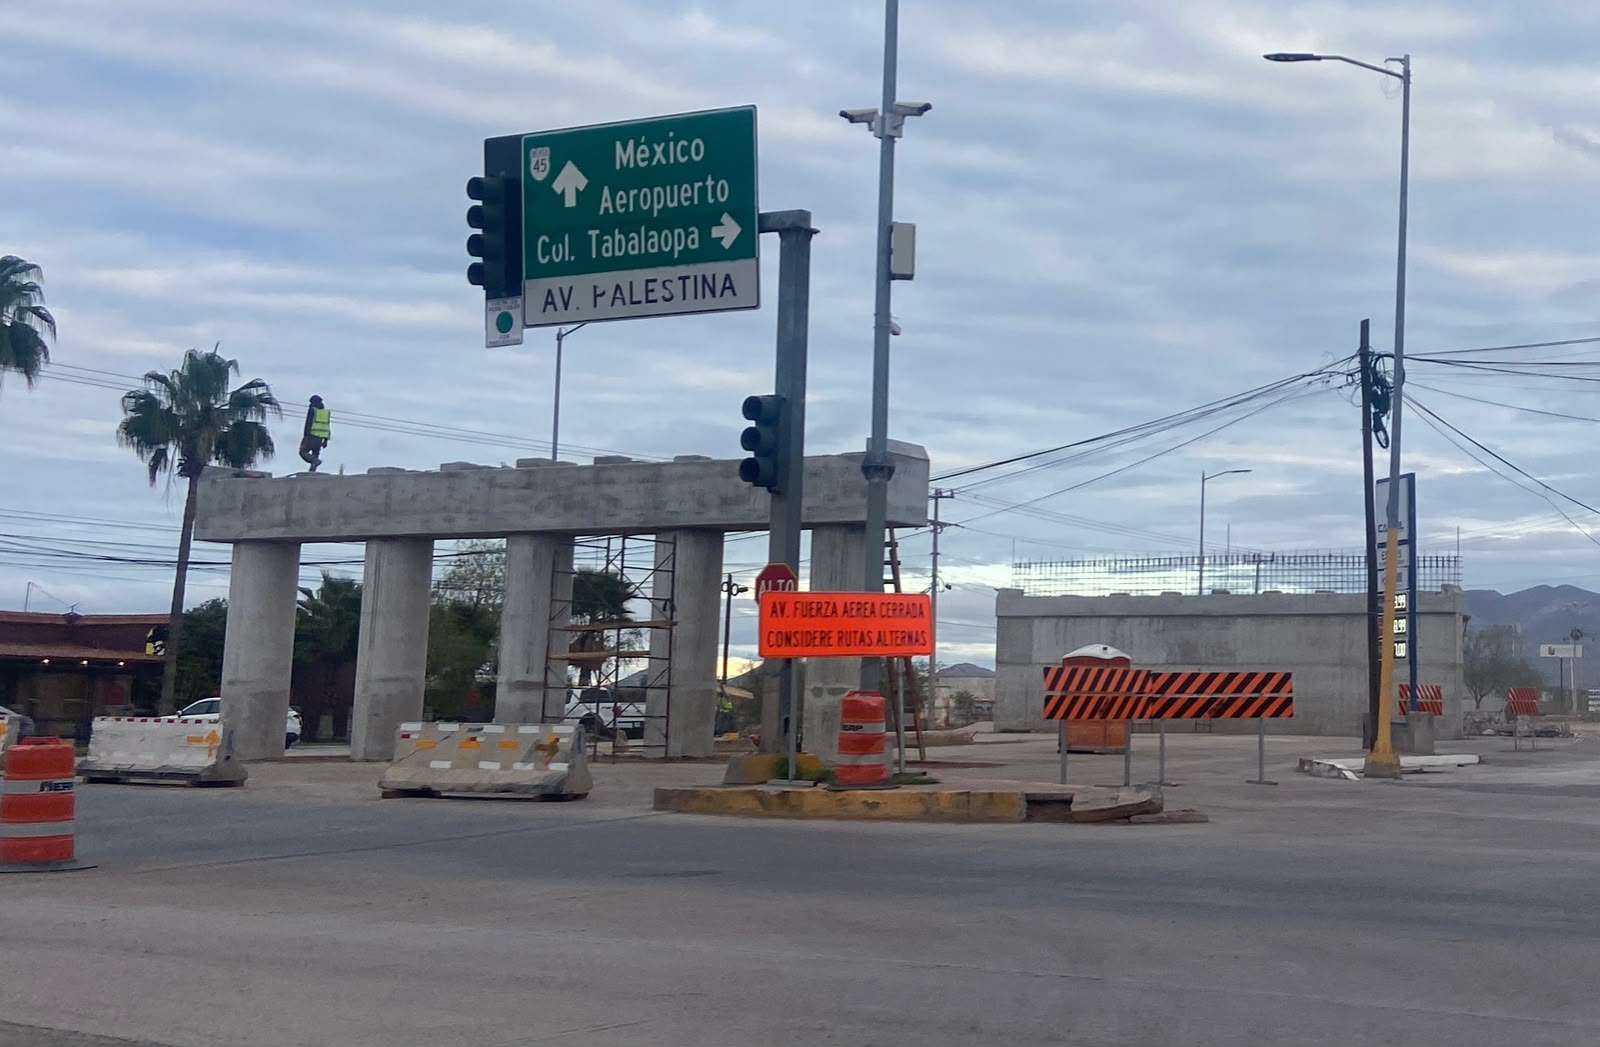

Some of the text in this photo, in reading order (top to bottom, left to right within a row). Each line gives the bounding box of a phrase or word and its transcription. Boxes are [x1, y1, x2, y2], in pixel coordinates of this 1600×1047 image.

[615, 132, 705, 170] México
[533, 158, 547, 173] 45
[600, 174, 729, 217] Aeropuerto
[588, 225, 699, 258] Tabalaopa
[542, 286, 580, 313] AV.
[770, 601, 924, 619] AV. FUERZA AEREA CERRADA
[767, 630, 927, 648] CONSIDERE RUTAS ALTERNAS
